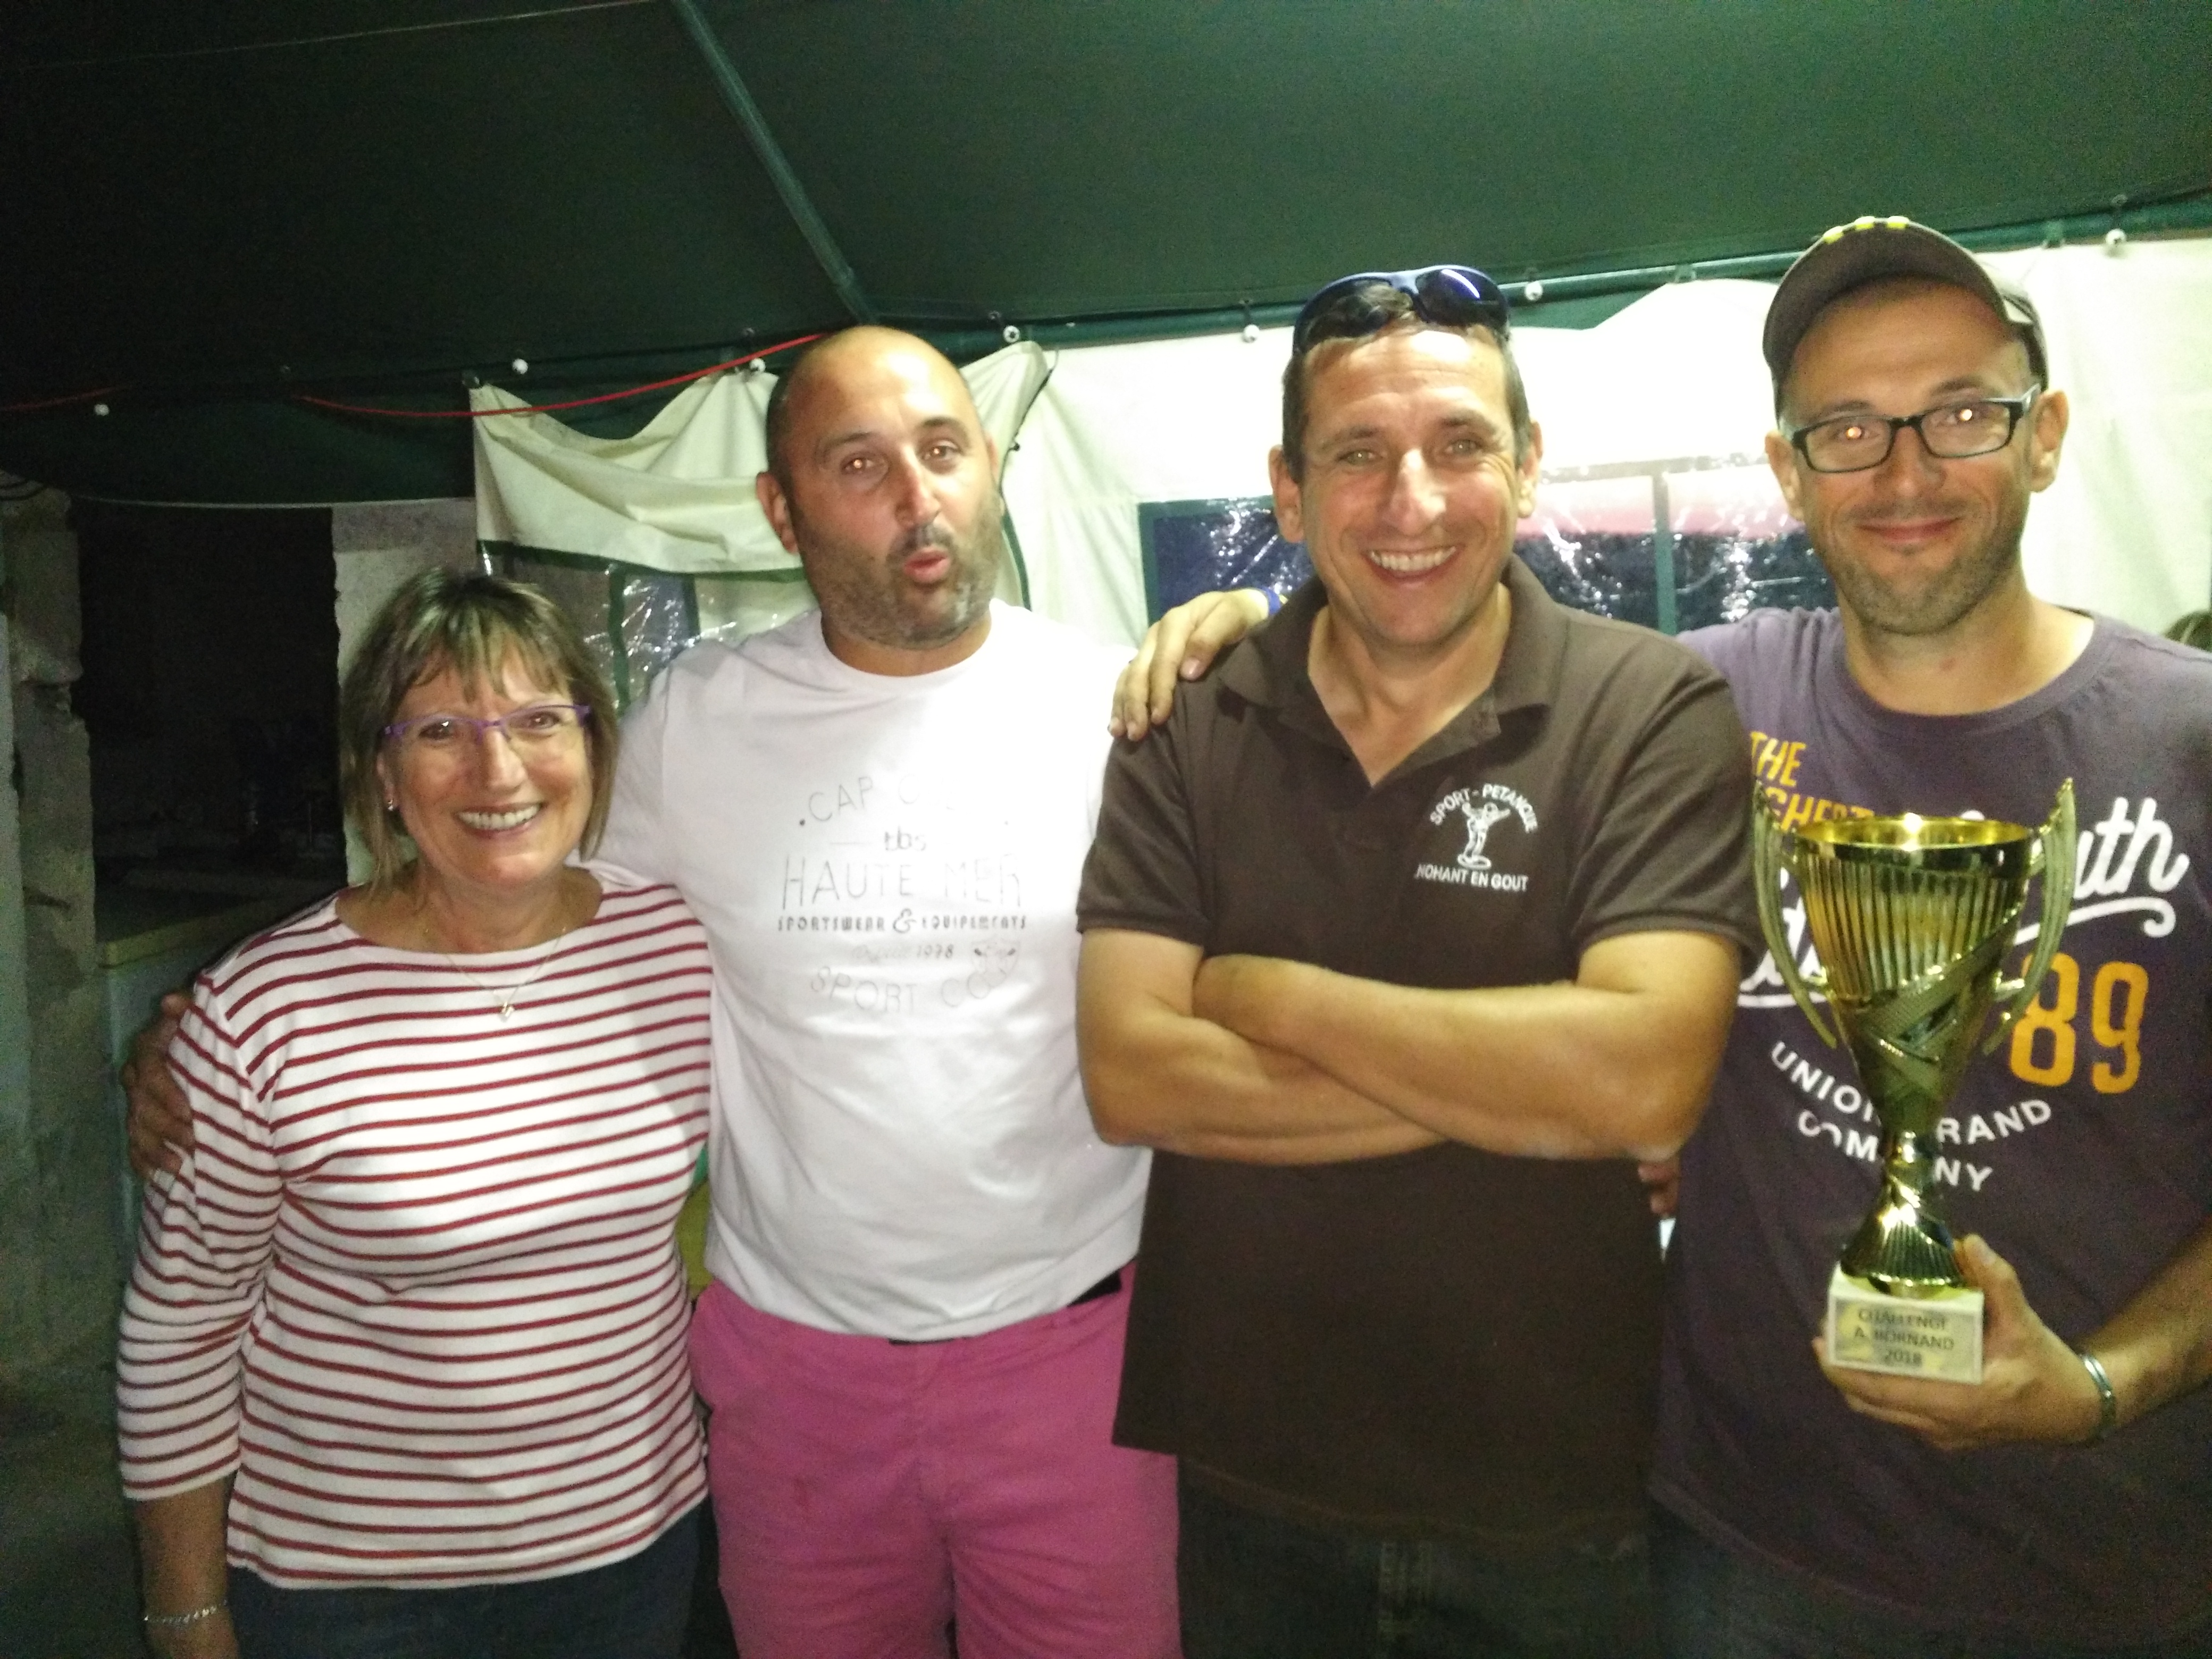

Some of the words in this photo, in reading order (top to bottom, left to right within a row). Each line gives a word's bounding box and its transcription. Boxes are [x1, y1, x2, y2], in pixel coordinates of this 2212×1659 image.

[1750, 731, 1807, 787] THE
[808, 776, 874, 822] CAP
[1429, 787, 1470, 825] SPORT
[782, 854, 914, 910] HAUTE
[943, 853, 1022, 907] MER
[1414, 864, 1469, 885] NOHANT
[1471, 871, 1489, 888] EN
[1490, 873, 1529, 892] GOUT
[892, 908, 916, 934] &
[810, 965, 919, 1013] SPORT
[2008, 952, 2150, 1095] 89
[1934, 1099, 2052, 1146] RAND
